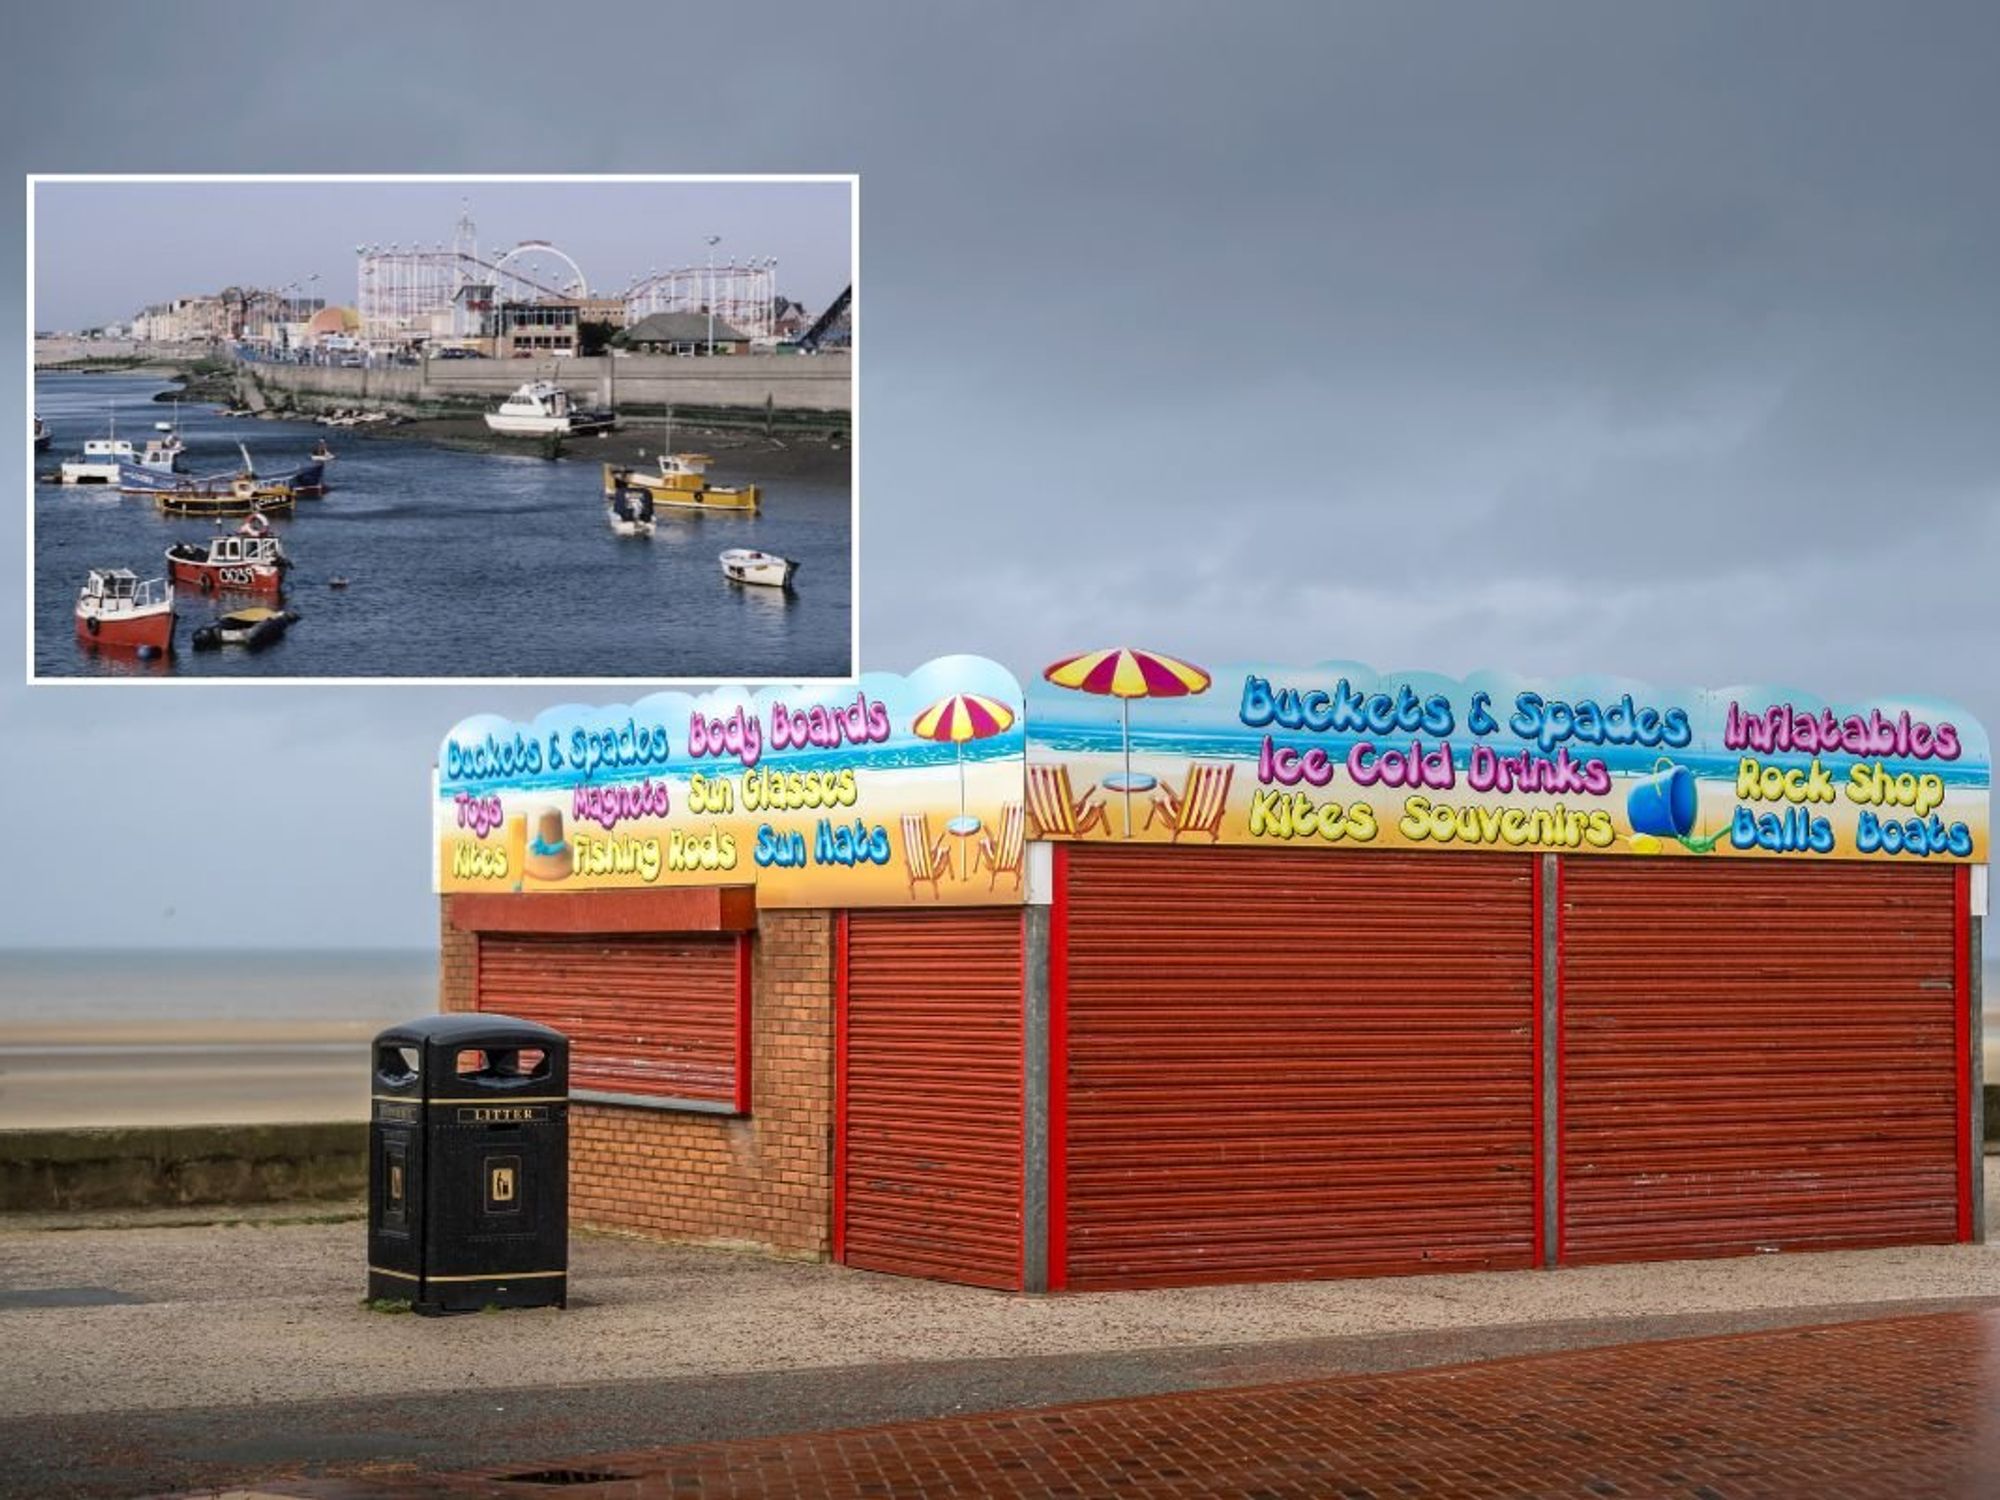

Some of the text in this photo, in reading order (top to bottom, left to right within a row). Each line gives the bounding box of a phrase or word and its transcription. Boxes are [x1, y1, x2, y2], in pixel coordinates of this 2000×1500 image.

[688, 691, 890, 767] Body Boards
[1240, 674, 1692, 752] Buckets & Spades
[1725, 701, 1961, 761] Inflatables
[448, 717, 670, 780] Buckets & Spades
[1258, 734, 1612, 796] Ice Cold Drinks
[454, 789, 503, 839] Toys
[572, 777, 670, 830] Magnets
[688, 765, 858, 814] Sun Glasses
[1736, 757, 1945, 818] Rock Shop
[754, 818, 891, 868] Sun Hats
[1249, 788, 1614, 848] Kites Souvenirs
[1730, 804, 1973, 857] Balls Boats
[453, 839, 508, 880] Kites
[572, 824, 737, 882] Fishing Rods
[475, 1109, 533, 1121] LITTER
